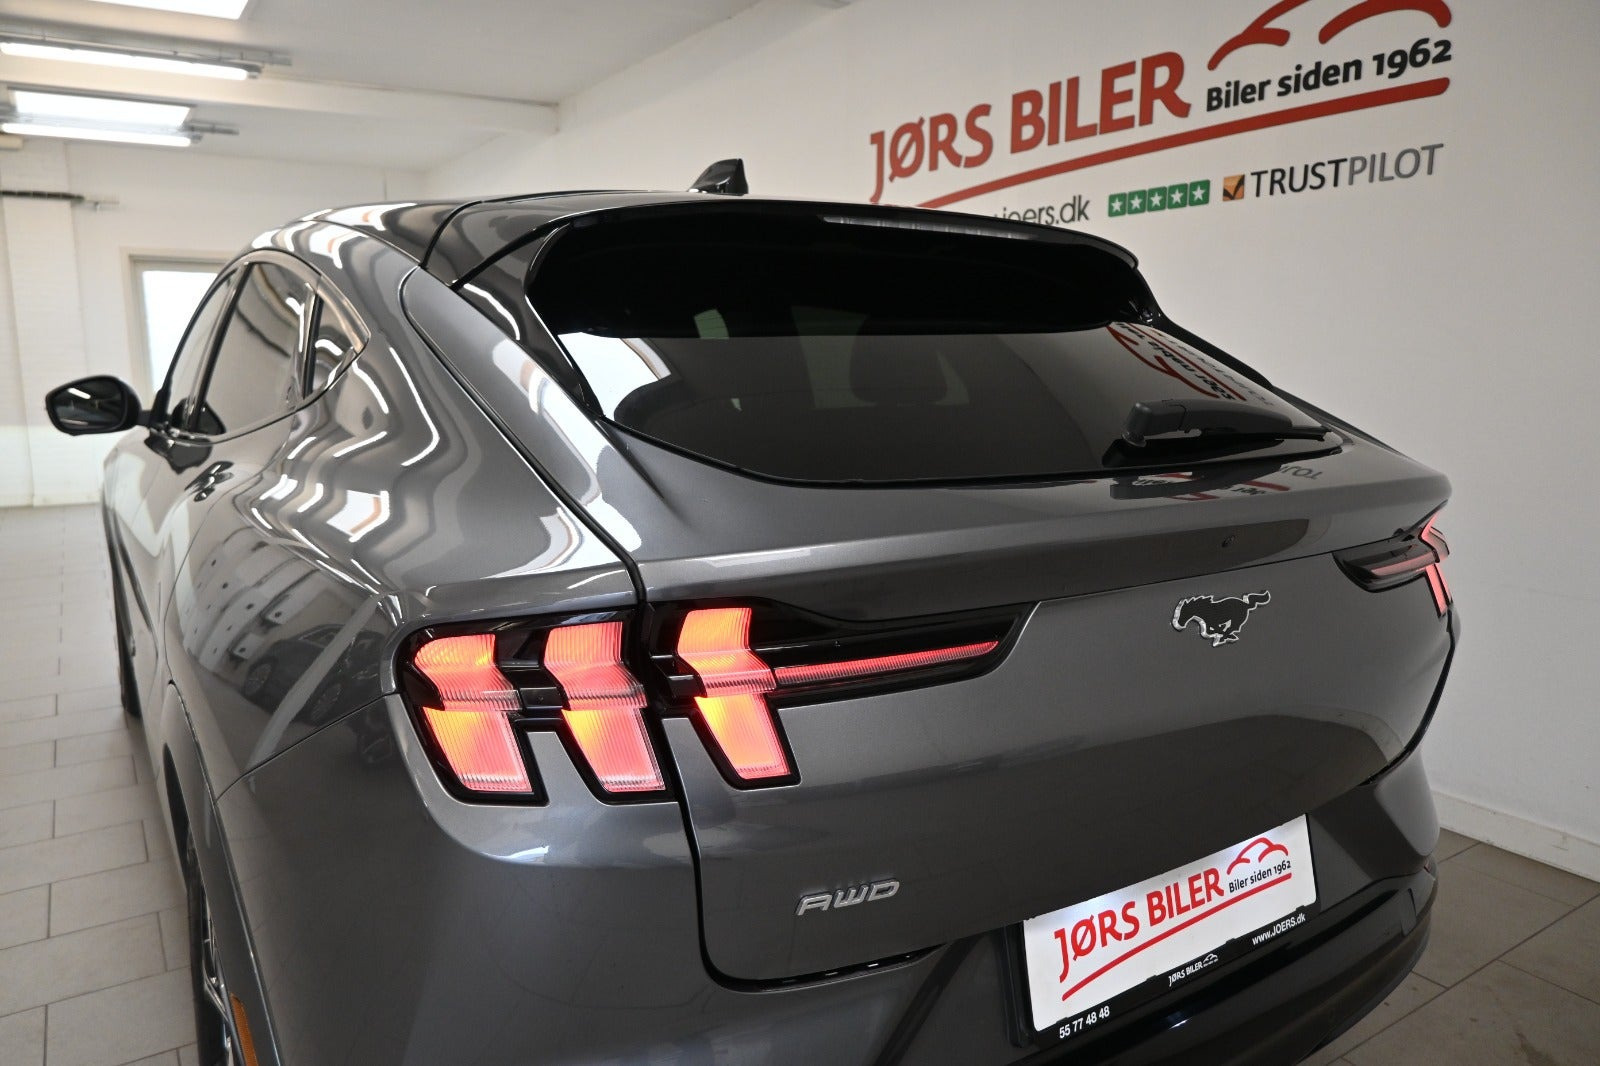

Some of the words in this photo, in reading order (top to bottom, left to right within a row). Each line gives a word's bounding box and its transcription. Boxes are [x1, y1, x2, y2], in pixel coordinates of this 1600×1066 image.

[869, 103, 993, 205] JØRS
[1010, 50, 1191, 155] BILER
[1206, 79, 1271, 112] Biler
[1276, 60, 1362, 97] siden
[1372, 38, 1453, 79] 1962
[1251, 143, 1444, 198] TRUSTPILOT
[795, 879, 900, 916] AWD
[1054, 901, 1140, 984] JØRS
[1146, 867, 1225, 927] BILER
[1229, 878, 1248, 893] Biler
[1250, 868, 1273, 884] siden
[1273, 860, 1292, 875] 1962
[1252, 912, 1306, 946] www.JOERS.dk
[1185, 961, 1203, 976] BILER
[1059, 1023, 1071, 1039] 55
[1072, 1017, 1084, 1033] 77
[1086, 1011, 1097, 1025] 48
[1098, 1005, 1110, 1019] 48
